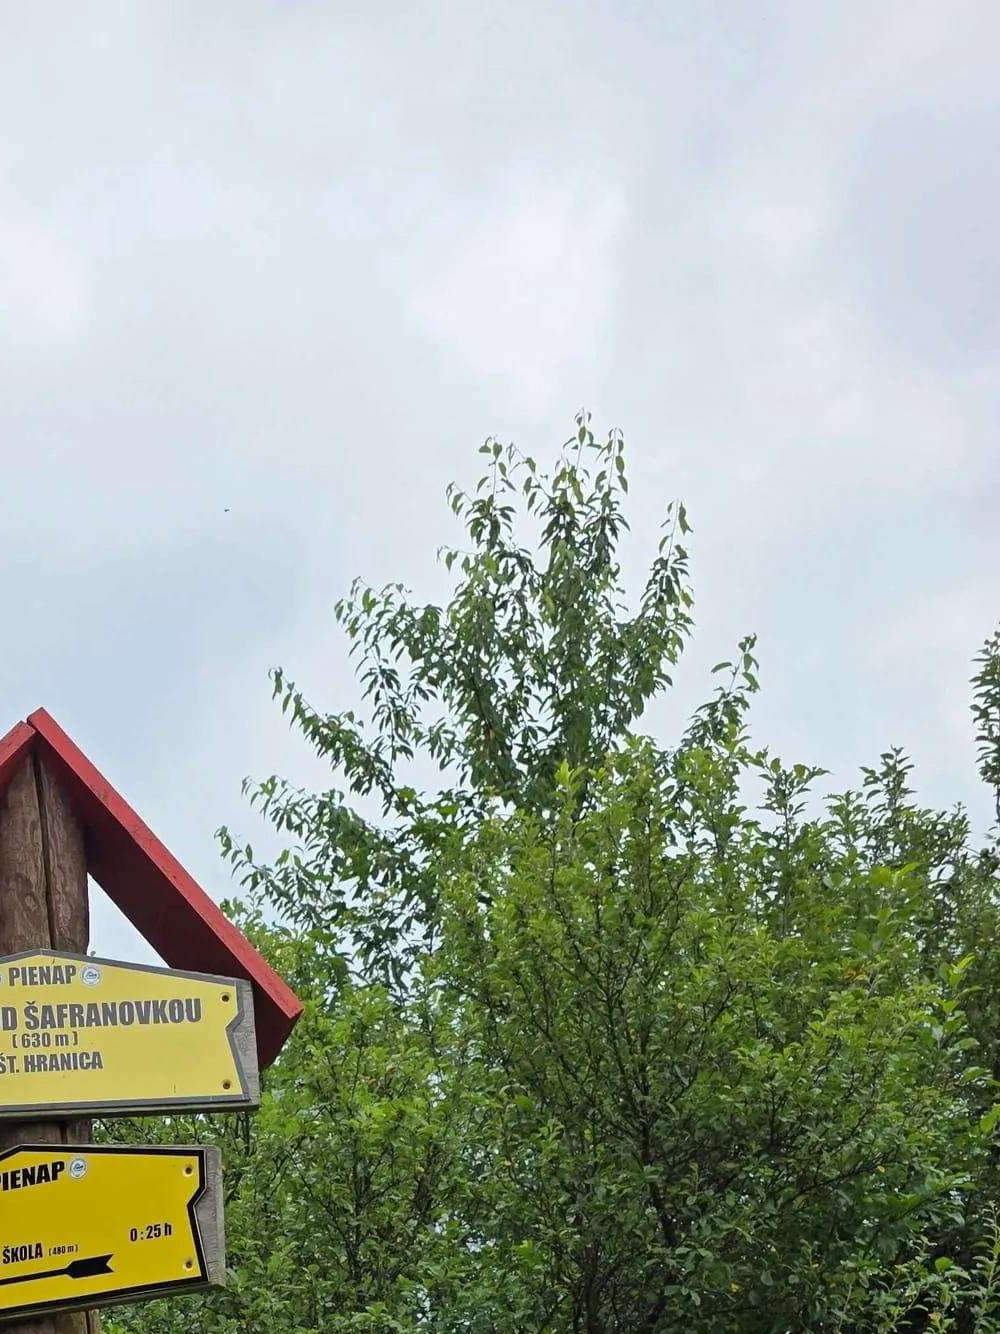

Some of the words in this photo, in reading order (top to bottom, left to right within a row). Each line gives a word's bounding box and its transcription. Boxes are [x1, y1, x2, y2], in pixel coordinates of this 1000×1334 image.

[8, 965, 77, 987] PIENAP
[24, 998, 202, 1030] ŠAFRANOVKOU
[23, 1051, 103, 1073] HRANICA
[2, 1243, 43, 1265] ŠKOLA
